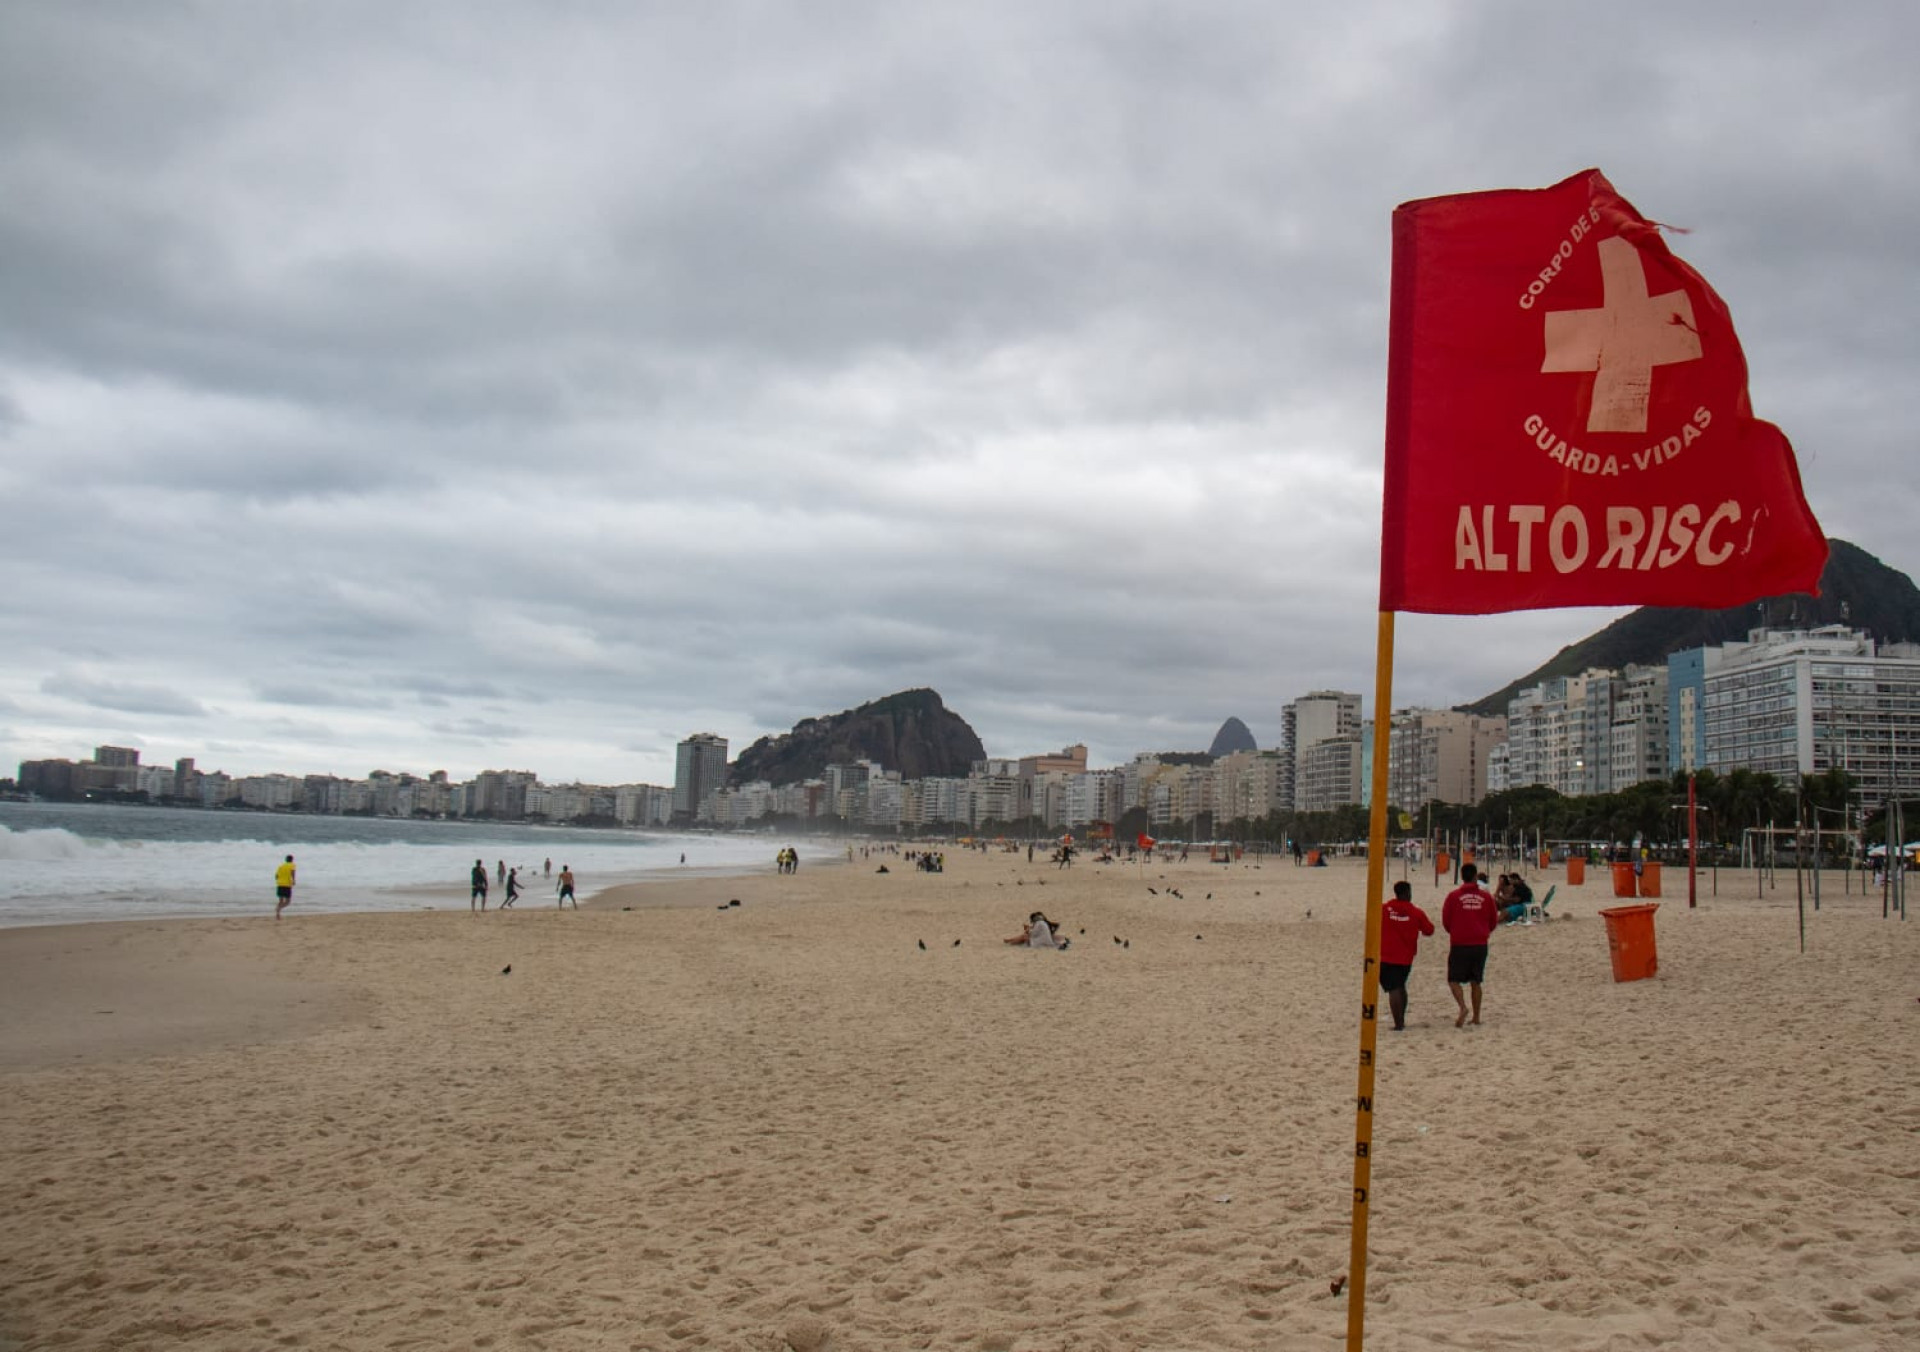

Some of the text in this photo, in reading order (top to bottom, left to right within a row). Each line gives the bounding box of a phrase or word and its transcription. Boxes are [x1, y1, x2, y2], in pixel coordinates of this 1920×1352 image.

[1519, 206, 1600, 309] CORPO DE B
[1523, 405, 1713, 476] GUARDA-VIDAS
[1455, 499, 1770, 574] ALTO RISC
